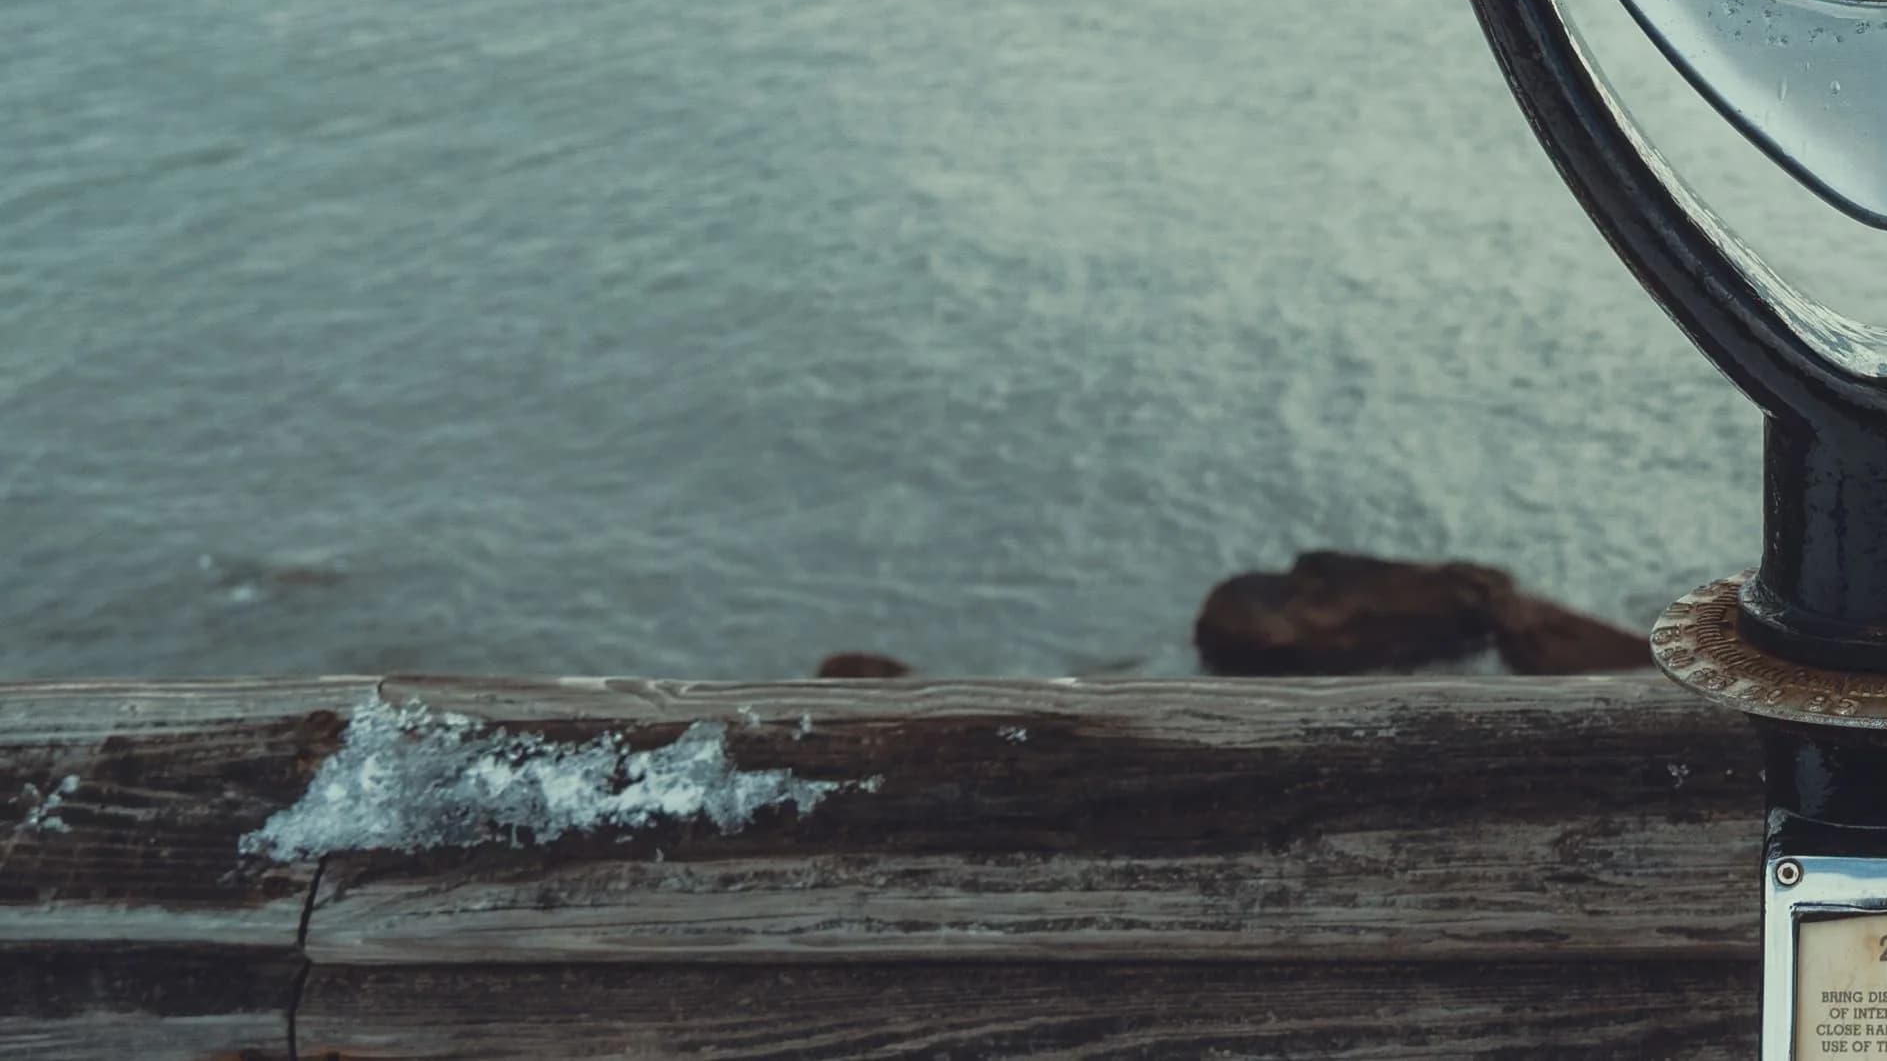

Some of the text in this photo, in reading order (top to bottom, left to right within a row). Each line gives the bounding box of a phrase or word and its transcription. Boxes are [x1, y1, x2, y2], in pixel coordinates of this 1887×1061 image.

[1821, 991, 1863, 1003] BRING
[1829, 1007, 1849, 1019] OF
[1816, 1024, 1861, 1036] CLOSE
[1822, 1040, 1848, 1053] USE
[1852, 1040, 1872, 1053] OF
